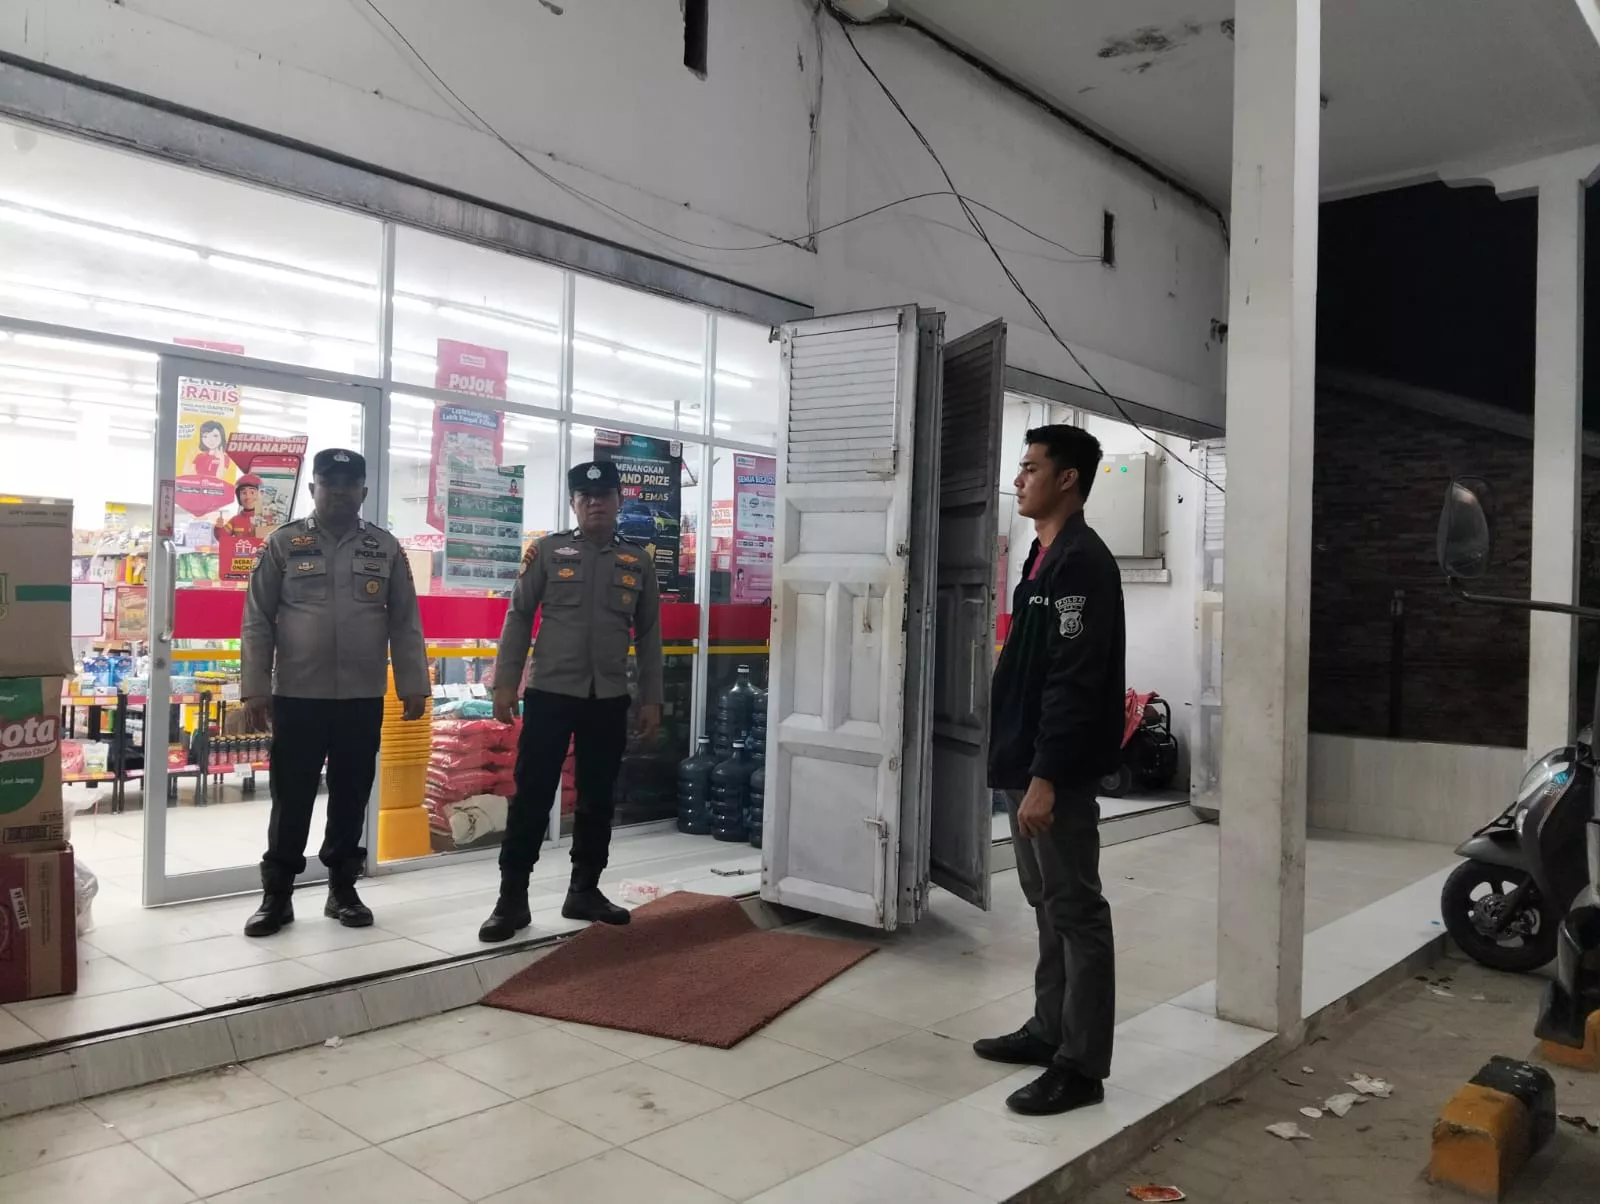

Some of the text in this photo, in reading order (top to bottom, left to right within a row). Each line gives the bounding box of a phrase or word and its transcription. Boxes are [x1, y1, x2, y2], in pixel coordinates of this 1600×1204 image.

[448, 373, 495, 394] POJOK
[181, 385, 239, 403] RATIS
[227, 441, 306, 454] DIMANAPUN
[616, 462, 664, 474] MENANGKAN
[618, 473, 670, 486] AND PRIZE
[622, 487, 637, 496] BIL
[645, 493, 669, 501] EMAS
[0, 716, 55, 747] ota
